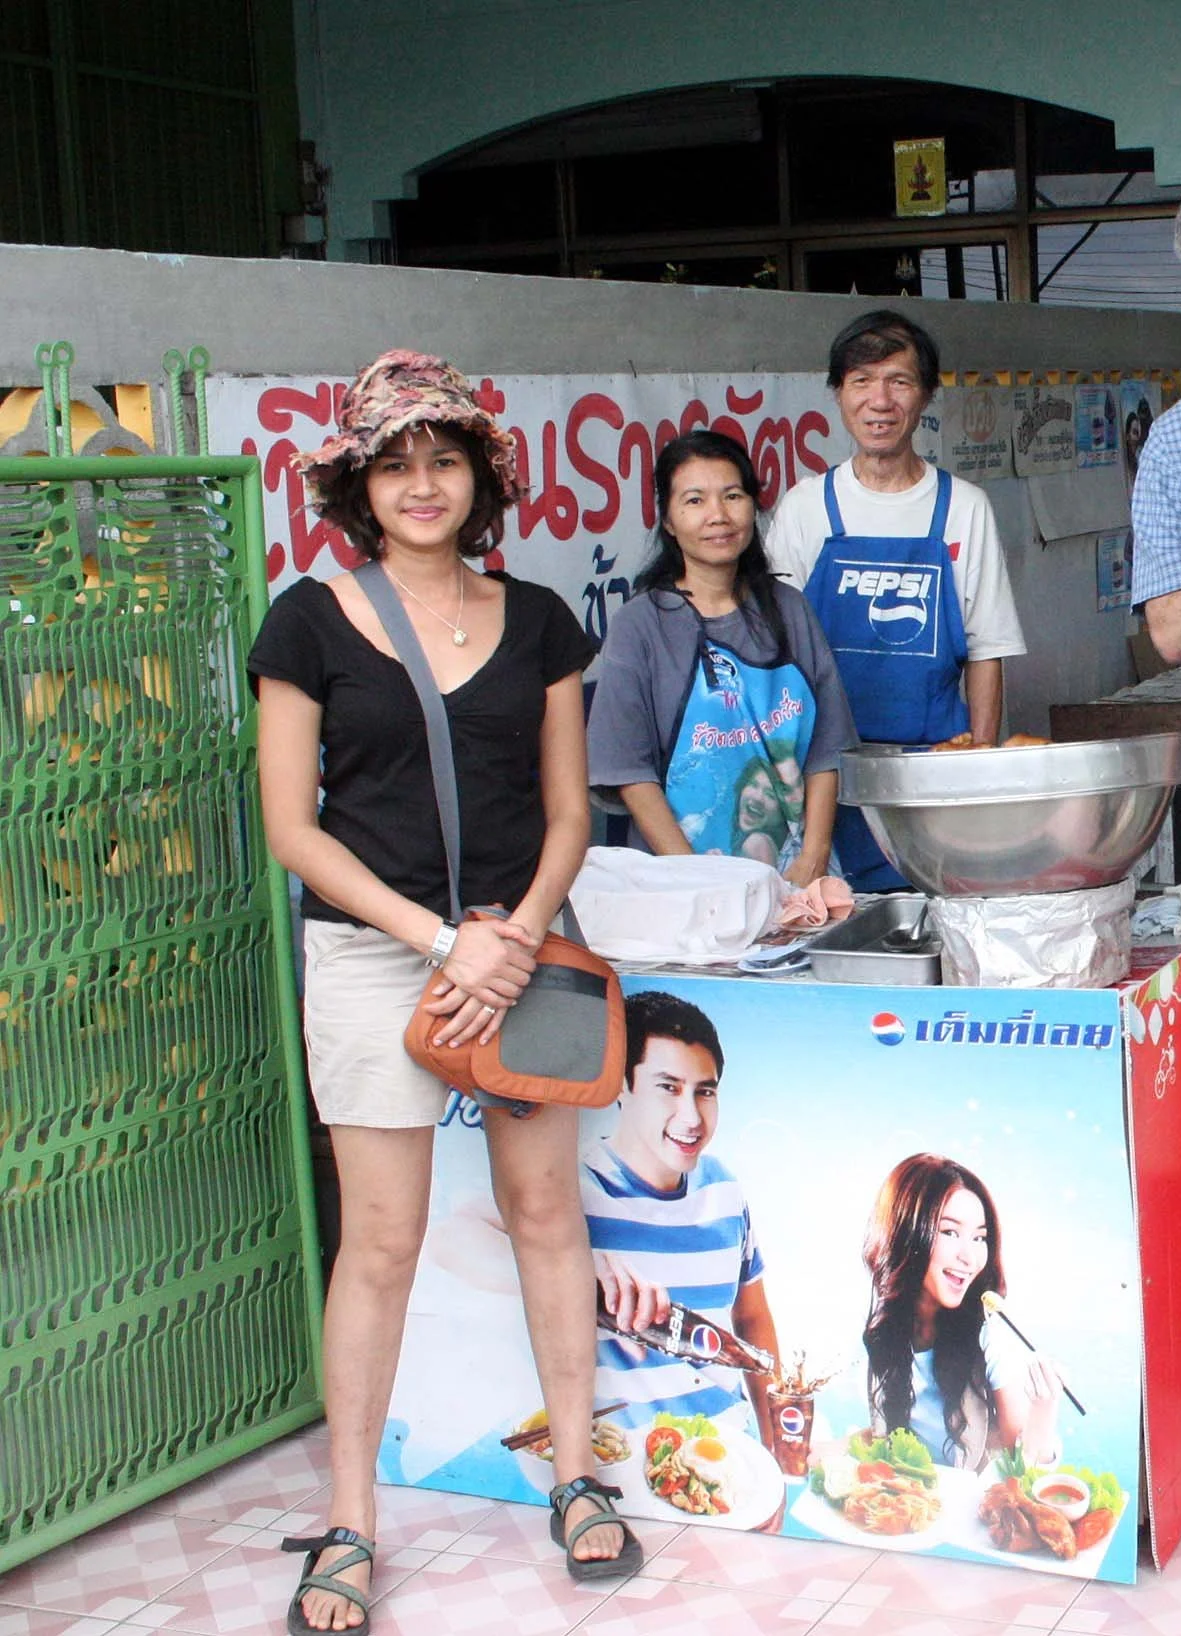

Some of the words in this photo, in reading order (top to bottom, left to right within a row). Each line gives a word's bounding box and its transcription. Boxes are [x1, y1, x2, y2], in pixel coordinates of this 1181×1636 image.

[837, 569, 932, 599] PEPSI
[915, 1008, 1115, 1049] เต็มที่เลย
